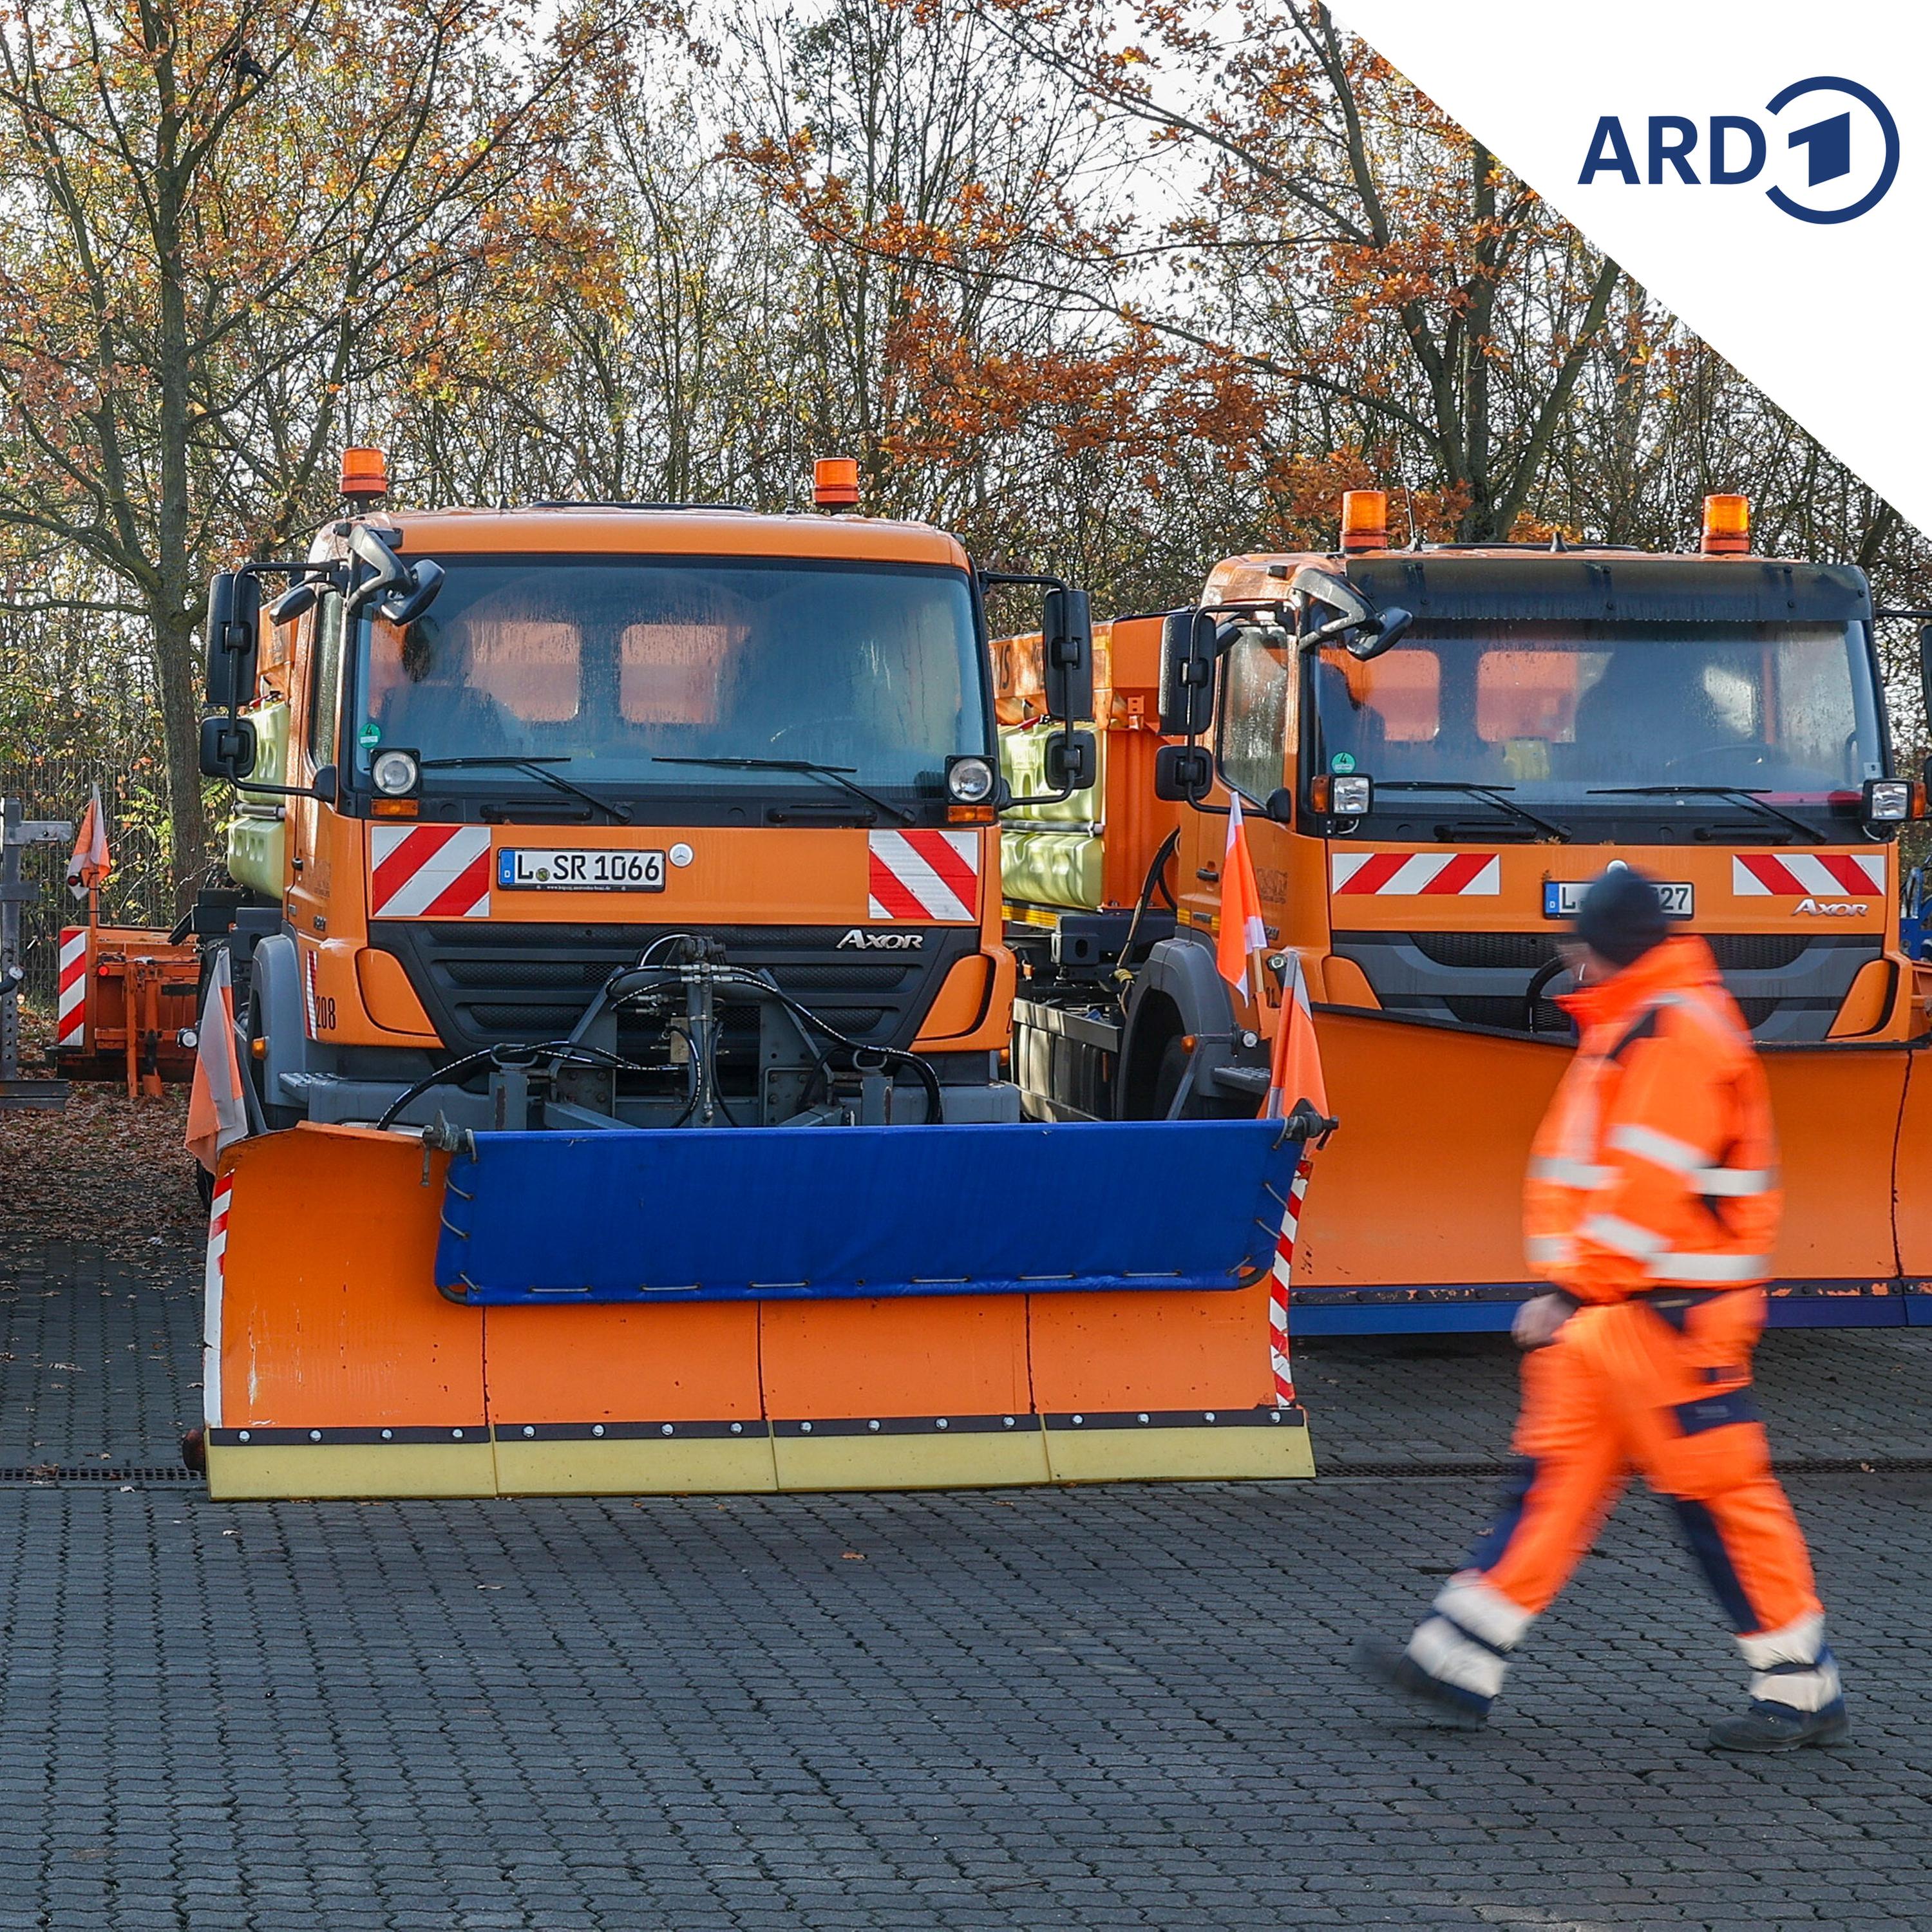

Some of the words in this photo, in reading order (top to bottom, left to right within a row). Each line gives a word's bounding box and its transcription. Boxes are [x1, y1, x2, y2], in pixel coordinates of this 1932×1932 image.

[366, 724, 372, 736] 4
[1340, 753, 1347, 764] 4
[504, 870, 511, 878] D
[518, 855, 534, 880] L
[553, 855, 587, 880] SR
[594, 855, 659, 881] 1066
[1562, 887, 1576, 909] L
[1649, 887, 1689, 910] 27
